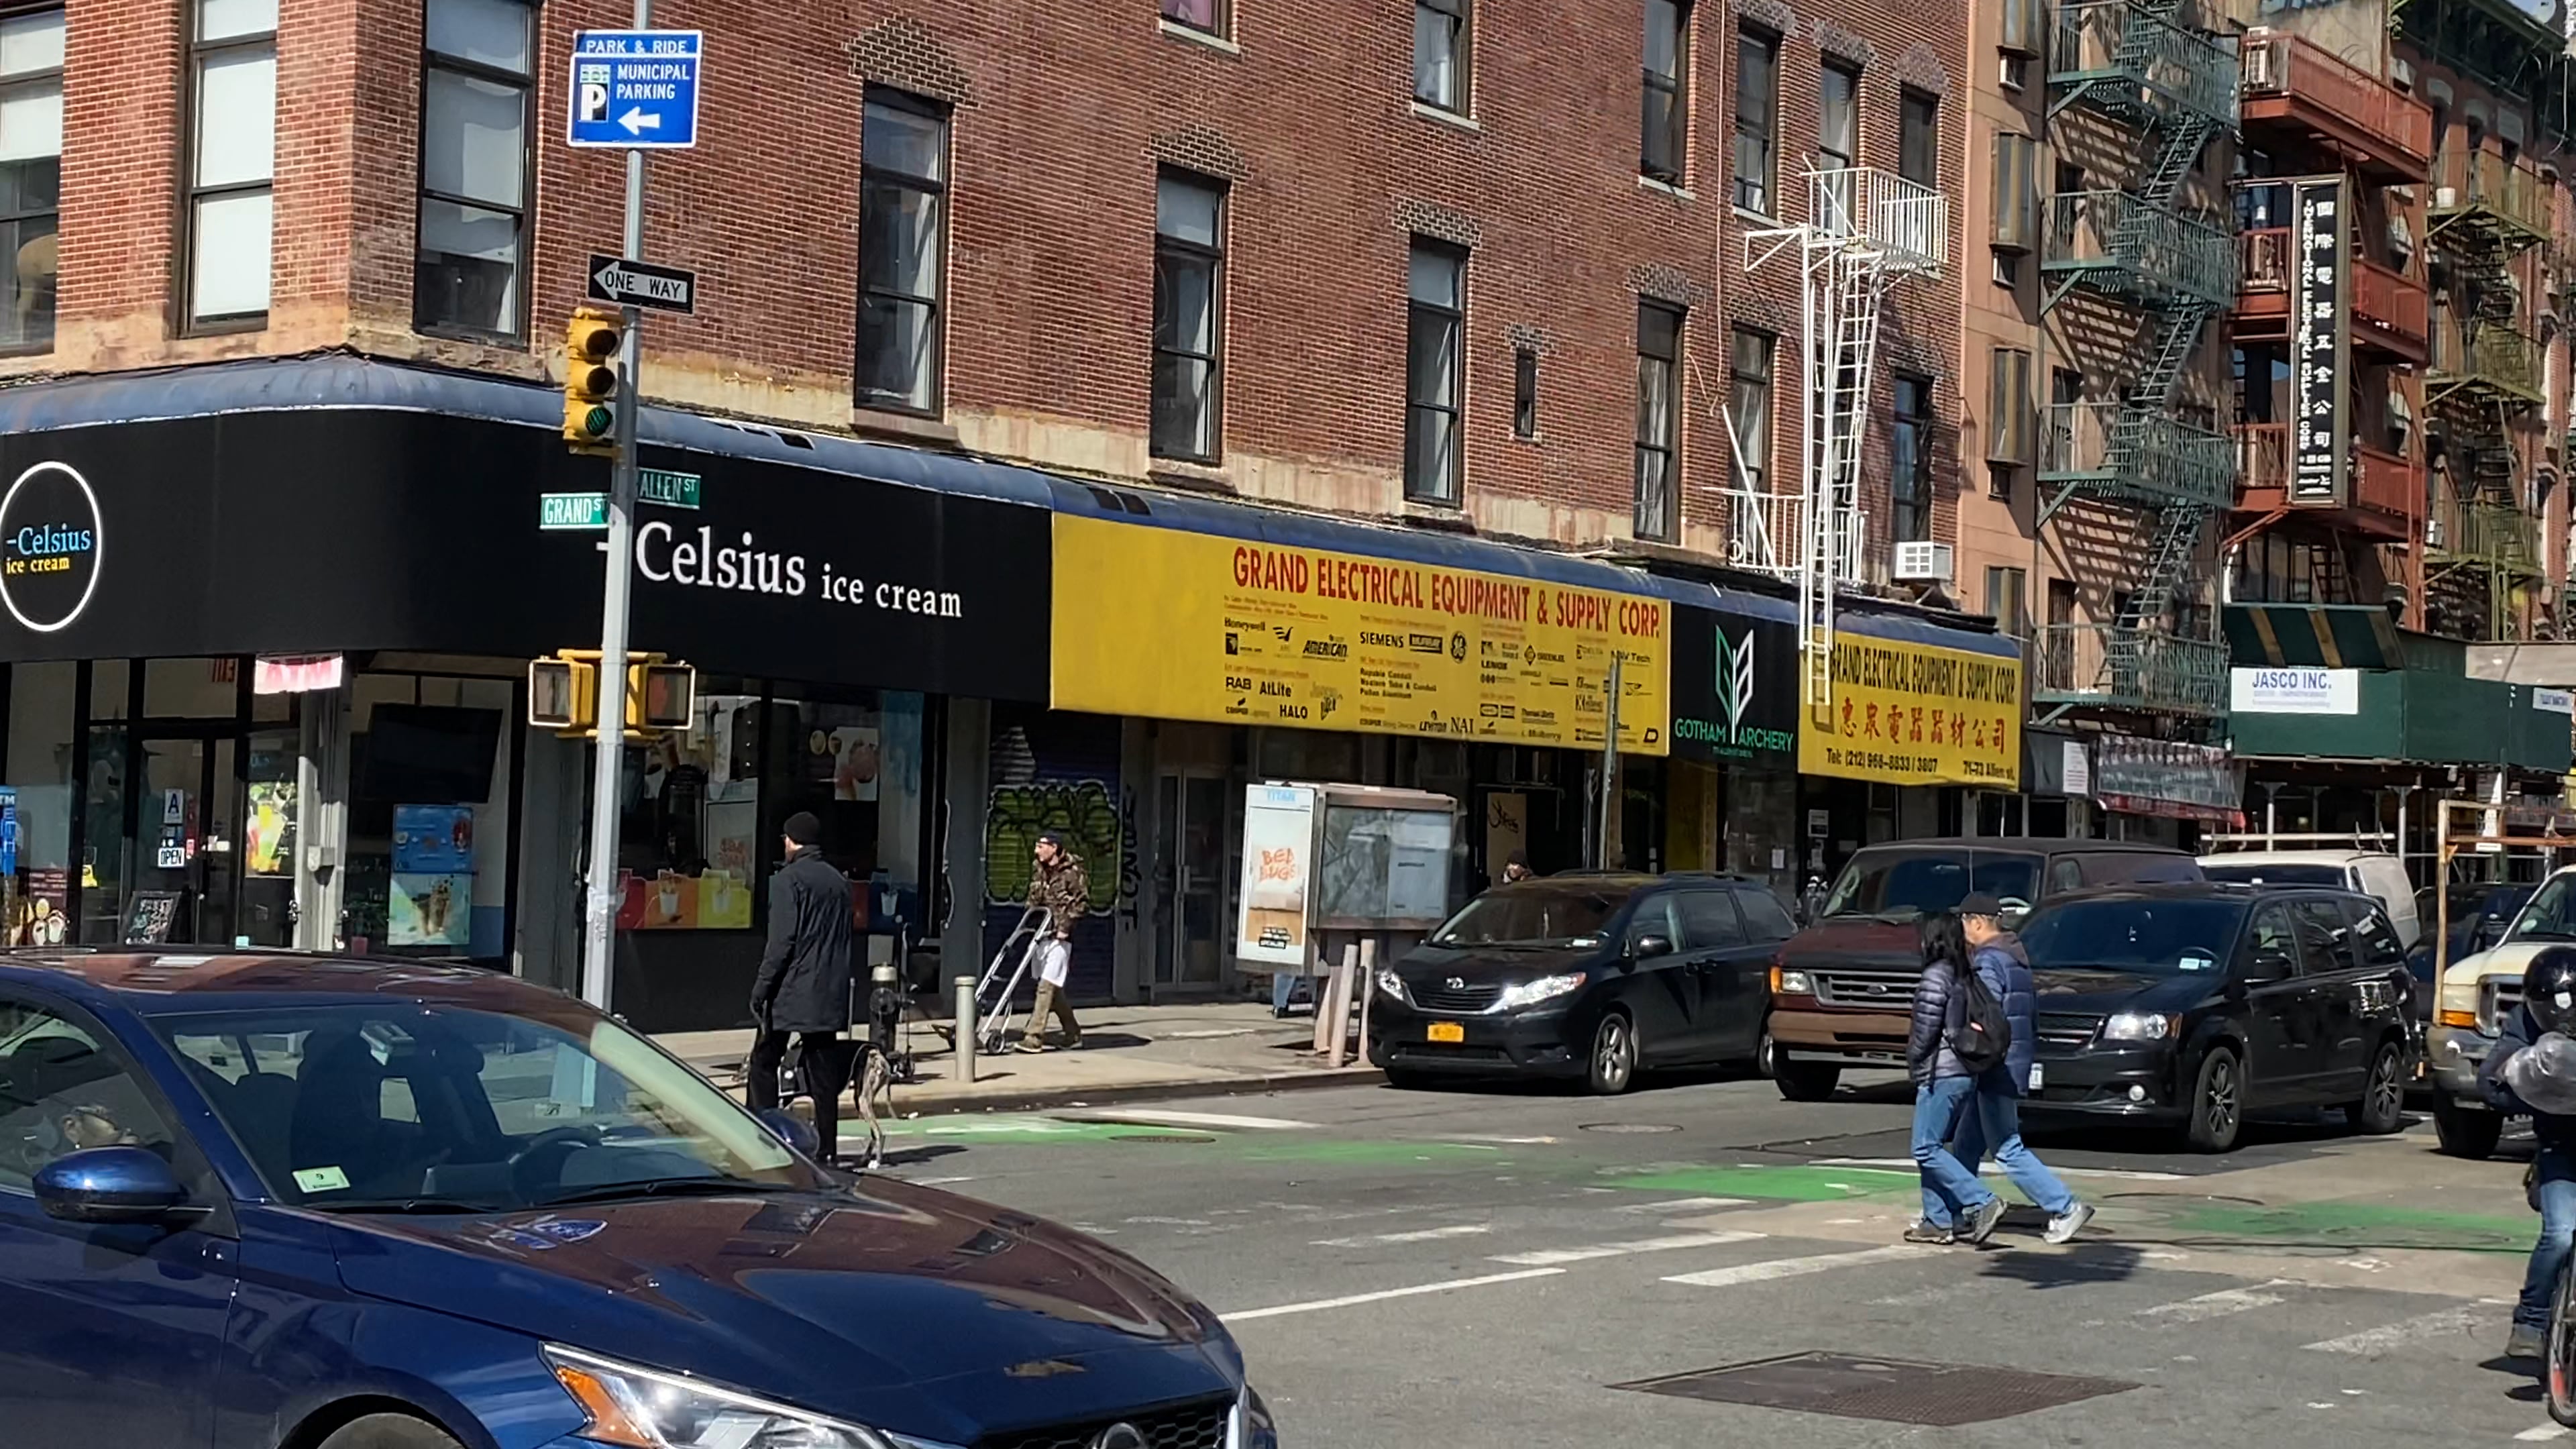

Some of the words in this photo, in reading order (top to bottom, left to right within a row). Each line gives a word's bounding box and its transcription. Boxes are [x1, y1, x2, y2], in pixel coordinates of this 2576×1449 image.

[586, 40, 627, 54] PARK
[634, 40, 645, 54] &
[652, 40, 687, 54] RIDE
[616, 64, 690, 80] MUNICIPAL
[616, 83, 676, 100] PARKING
[604, 270, 635, 292] ONE
[649, 277, 682, 299] WAY
[639, 472, 682, 501] ALLEN
[684, 478, 697, 492] ST
[544, 498, 593, 524] GRAND
[6, 557, 25, 575] ice
[30, 556, 70, 572] cream
[821, 562, 865, 604] ice
[875, 581, 963, 618] cream
[1233, 545, 1309, 594] GRAND
[1317, 557, 1424, 609] ELECTRICAL
[1431, 573, 1530, 623] EQUIPMENT
[1537, 590, 1548, 625] &
[1556, 590, 1612, 633] SUPPLY
[1224, 616, 1266, 632] Honeywell
[1359, 631, 1404, 649] SIEMENS
[1225, 676, 1252, 690] RAB
[2252, 672, 2298, 689] JASCO
[2303, 672, 2332, 690] INC.
[1279, 704, 1309, 720] HALO
[1674, 718, 1727, 743] GOTHAM
[1737, 727, 1794, 753] ARCHERY
[167, 793, 179, 814] A
[160, 849, 182, 865] OPEN
[1262, 848, 1294, 865] BED
